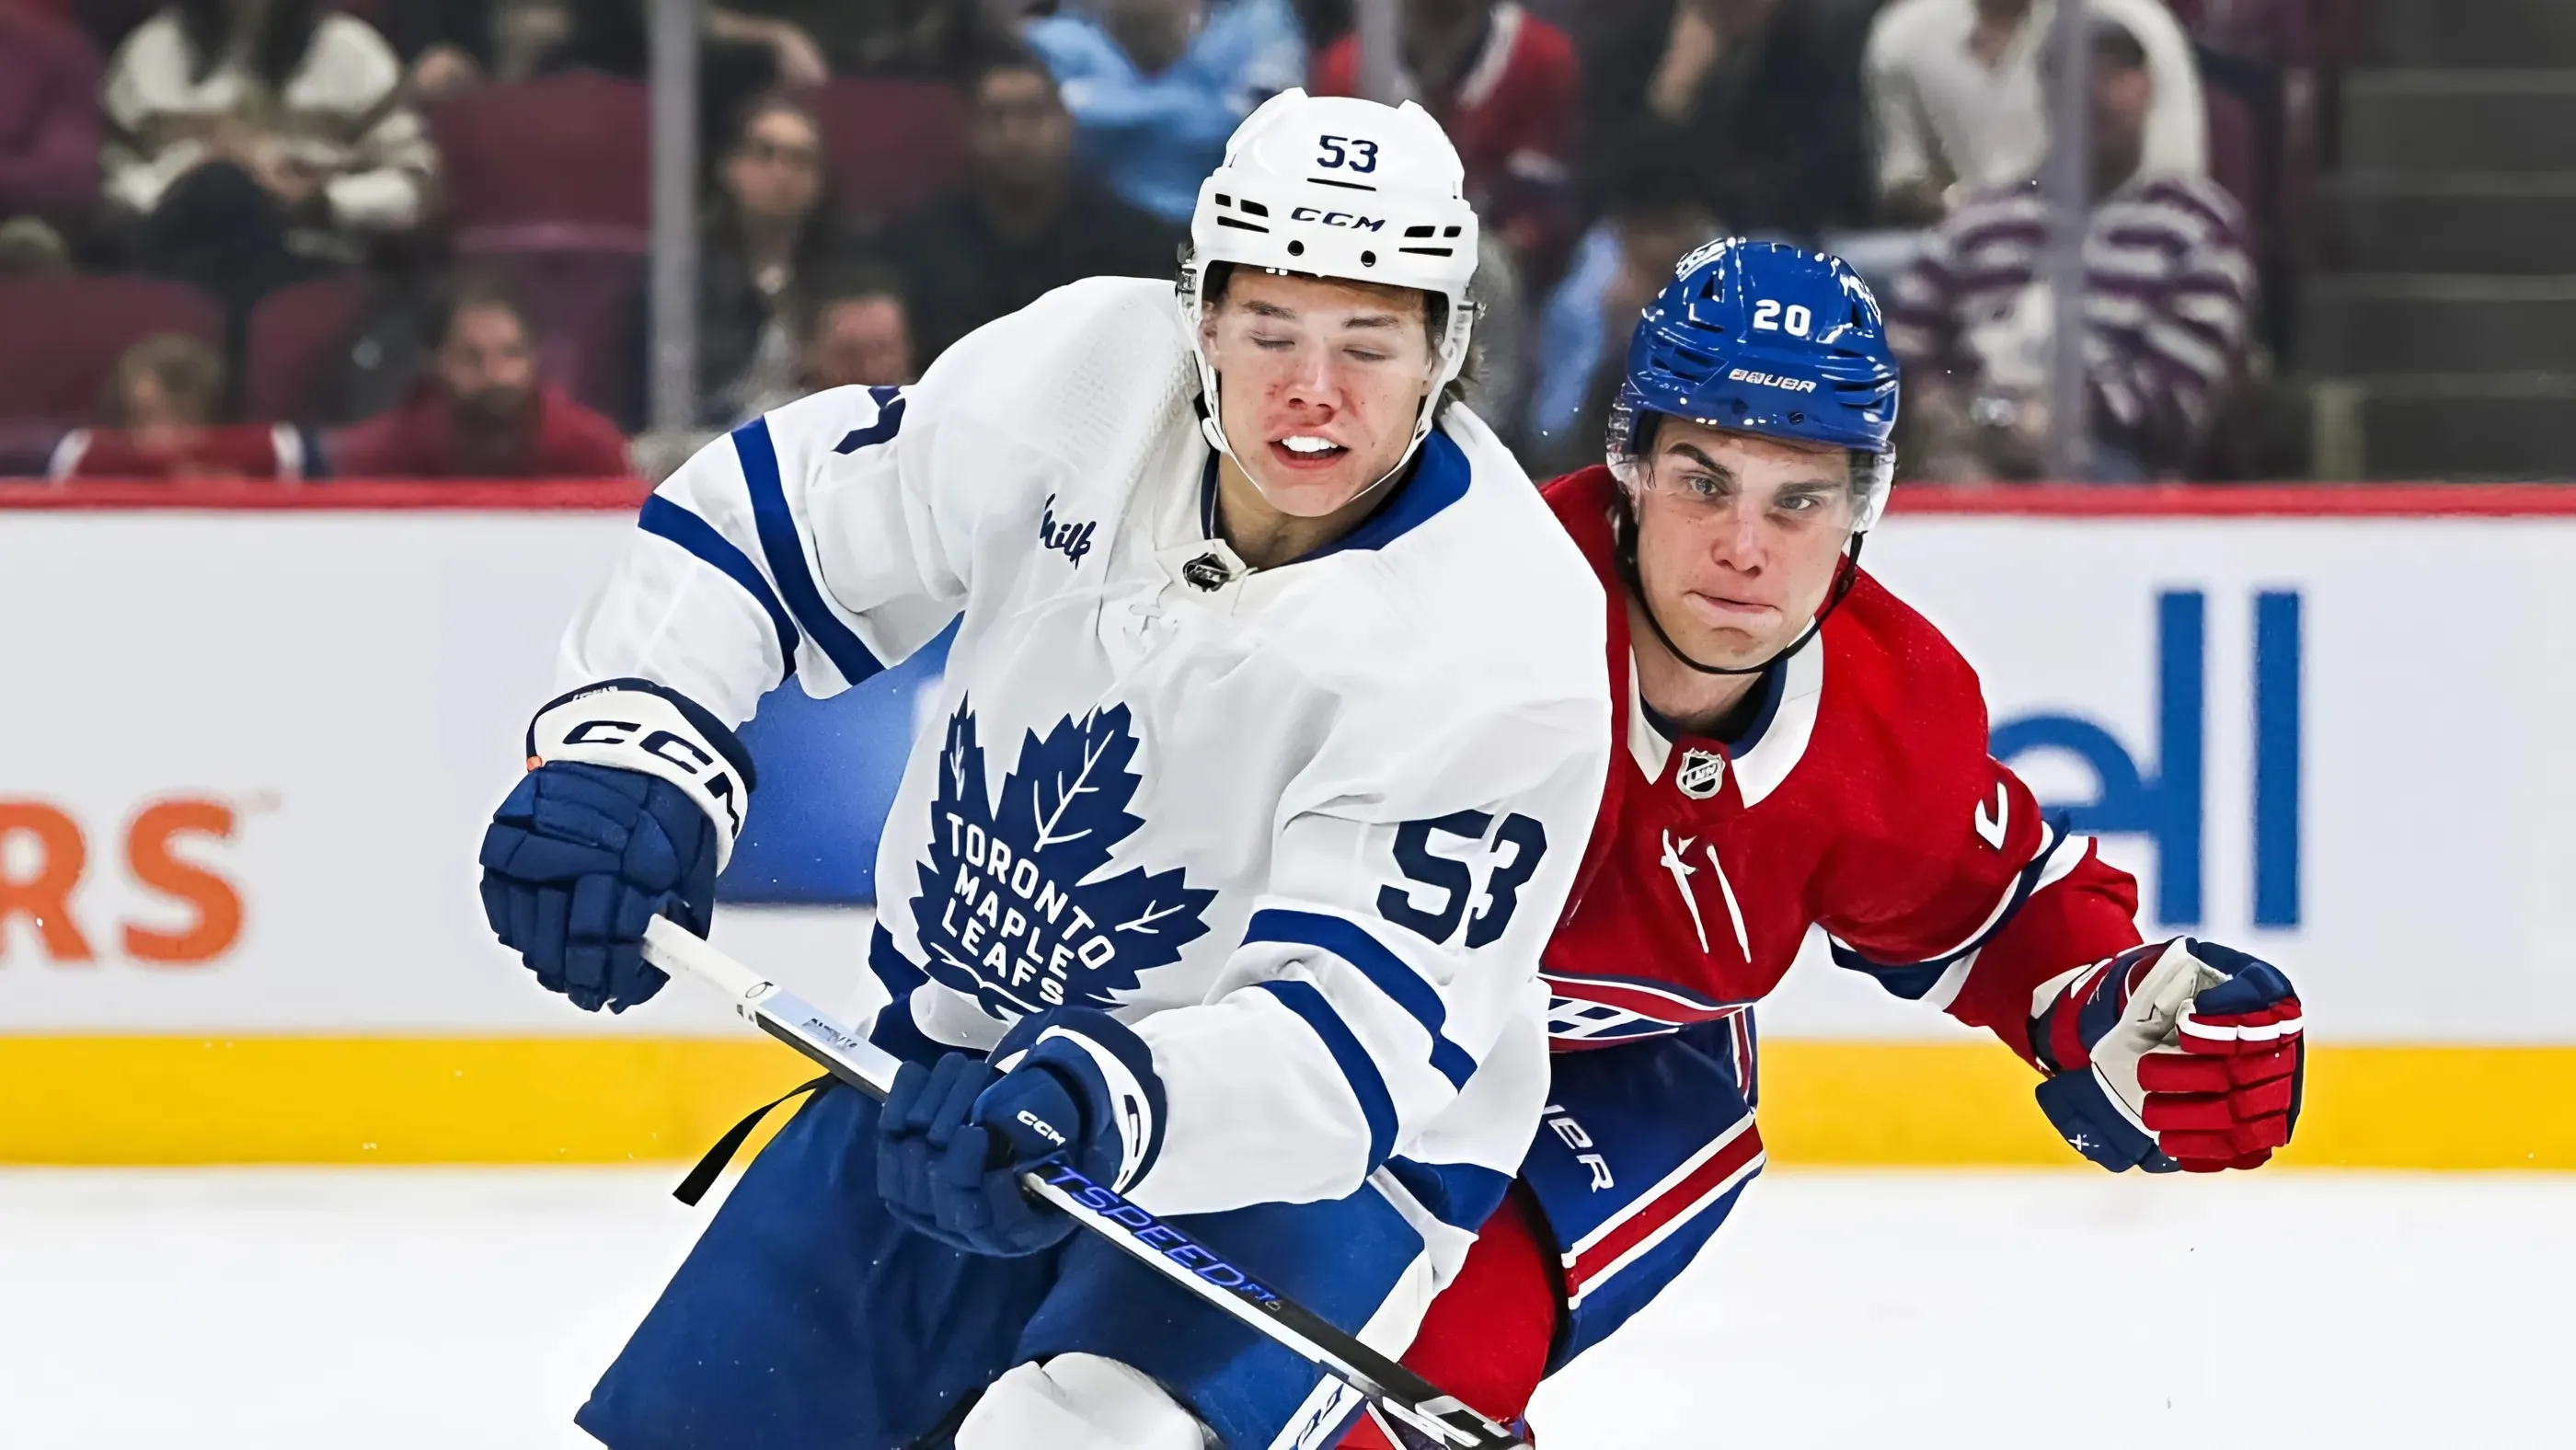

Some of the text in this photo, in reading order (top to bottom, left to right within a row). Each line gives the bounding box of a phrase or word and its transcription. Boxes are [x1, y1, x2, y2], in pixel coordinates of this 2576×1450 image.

[1316, 134, 1379, 174] 53
[1290, 206, 1386, 233] CCM
[1753, 299, 1811, 338] 20
[1728, 368, 1818, 394] BAUER
[946, 811, 1116, 971] TORONTO
[1375, 808, 1548, 949] 53
[941, 897, 1064, 1006] LEAFS
[953, 863, 1075, 981] MAPLE
[1016, 1109, 1067, 1147] CCM
[1047, 1160, 1246, 1288] TSPEED
